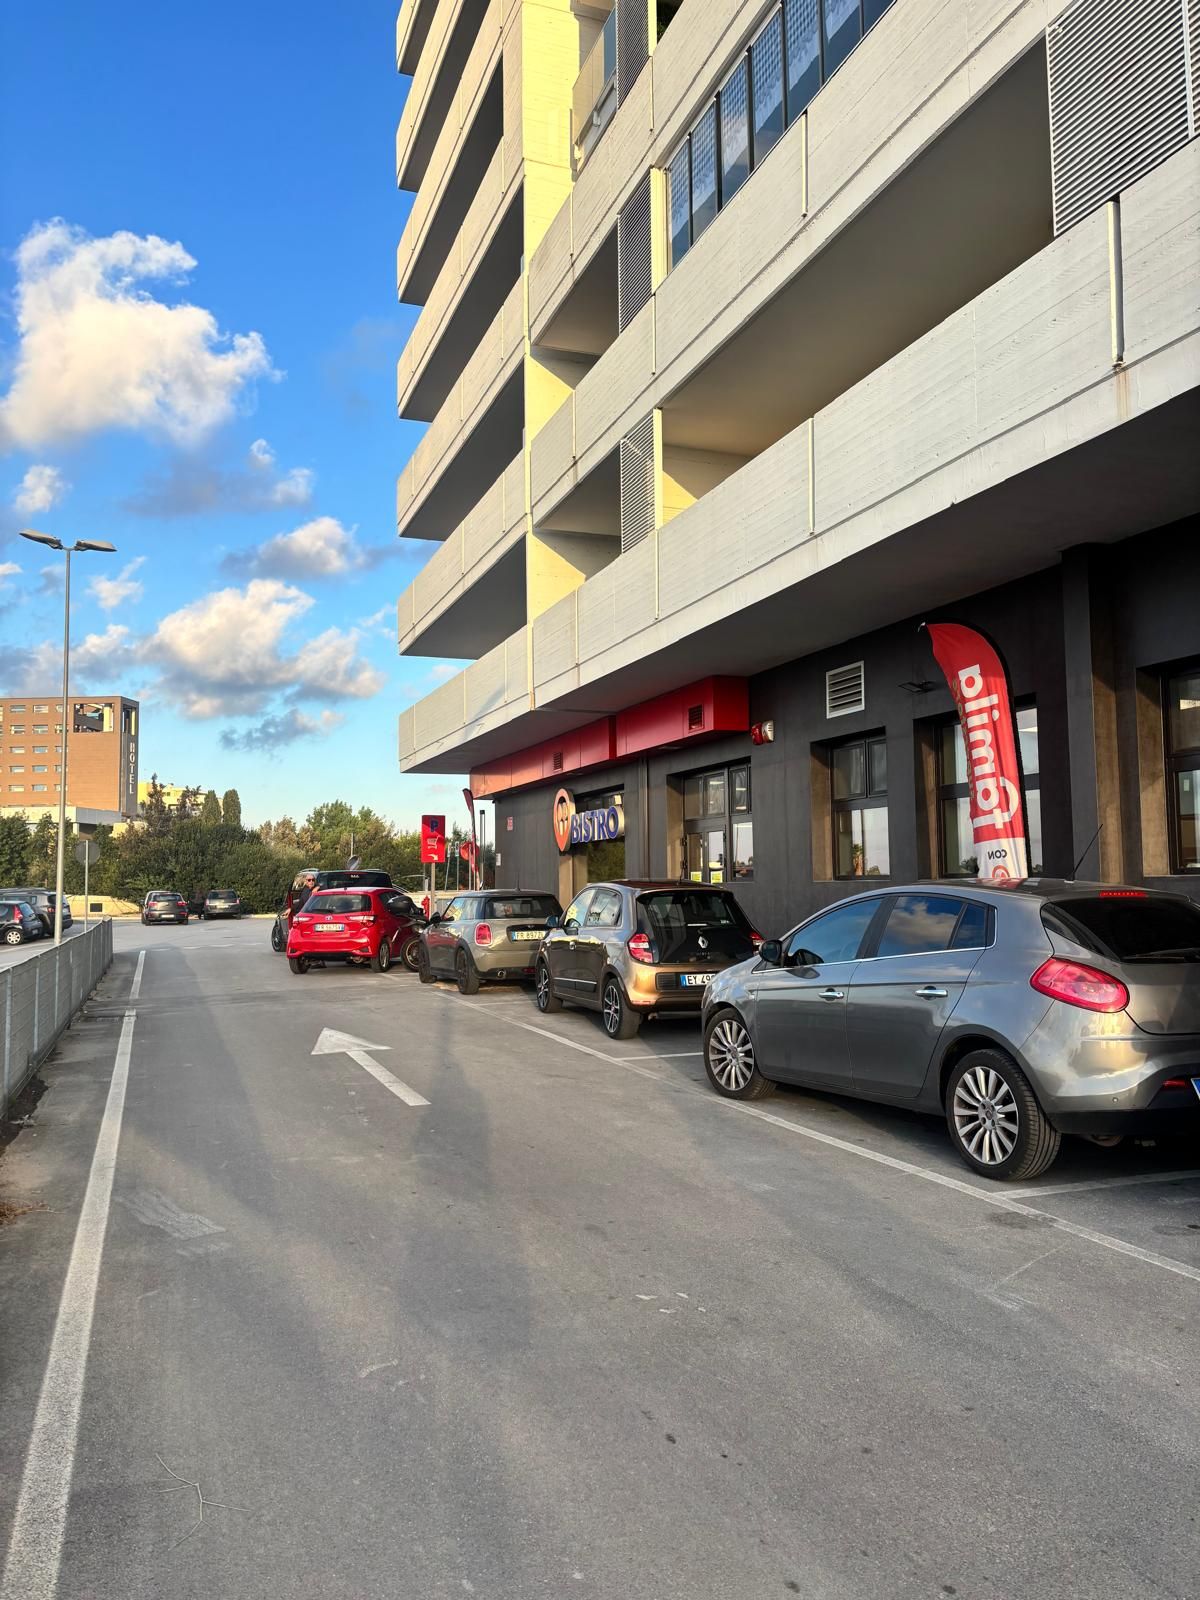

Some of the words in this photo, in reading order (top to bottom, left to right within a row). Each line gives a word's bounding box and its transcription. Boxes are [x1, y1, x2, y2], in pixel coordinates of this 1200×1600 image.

[430, 820, 439, 832] P
[571, 805, 619, 843] BISTRO
[687, 975, 697, 985] EY
